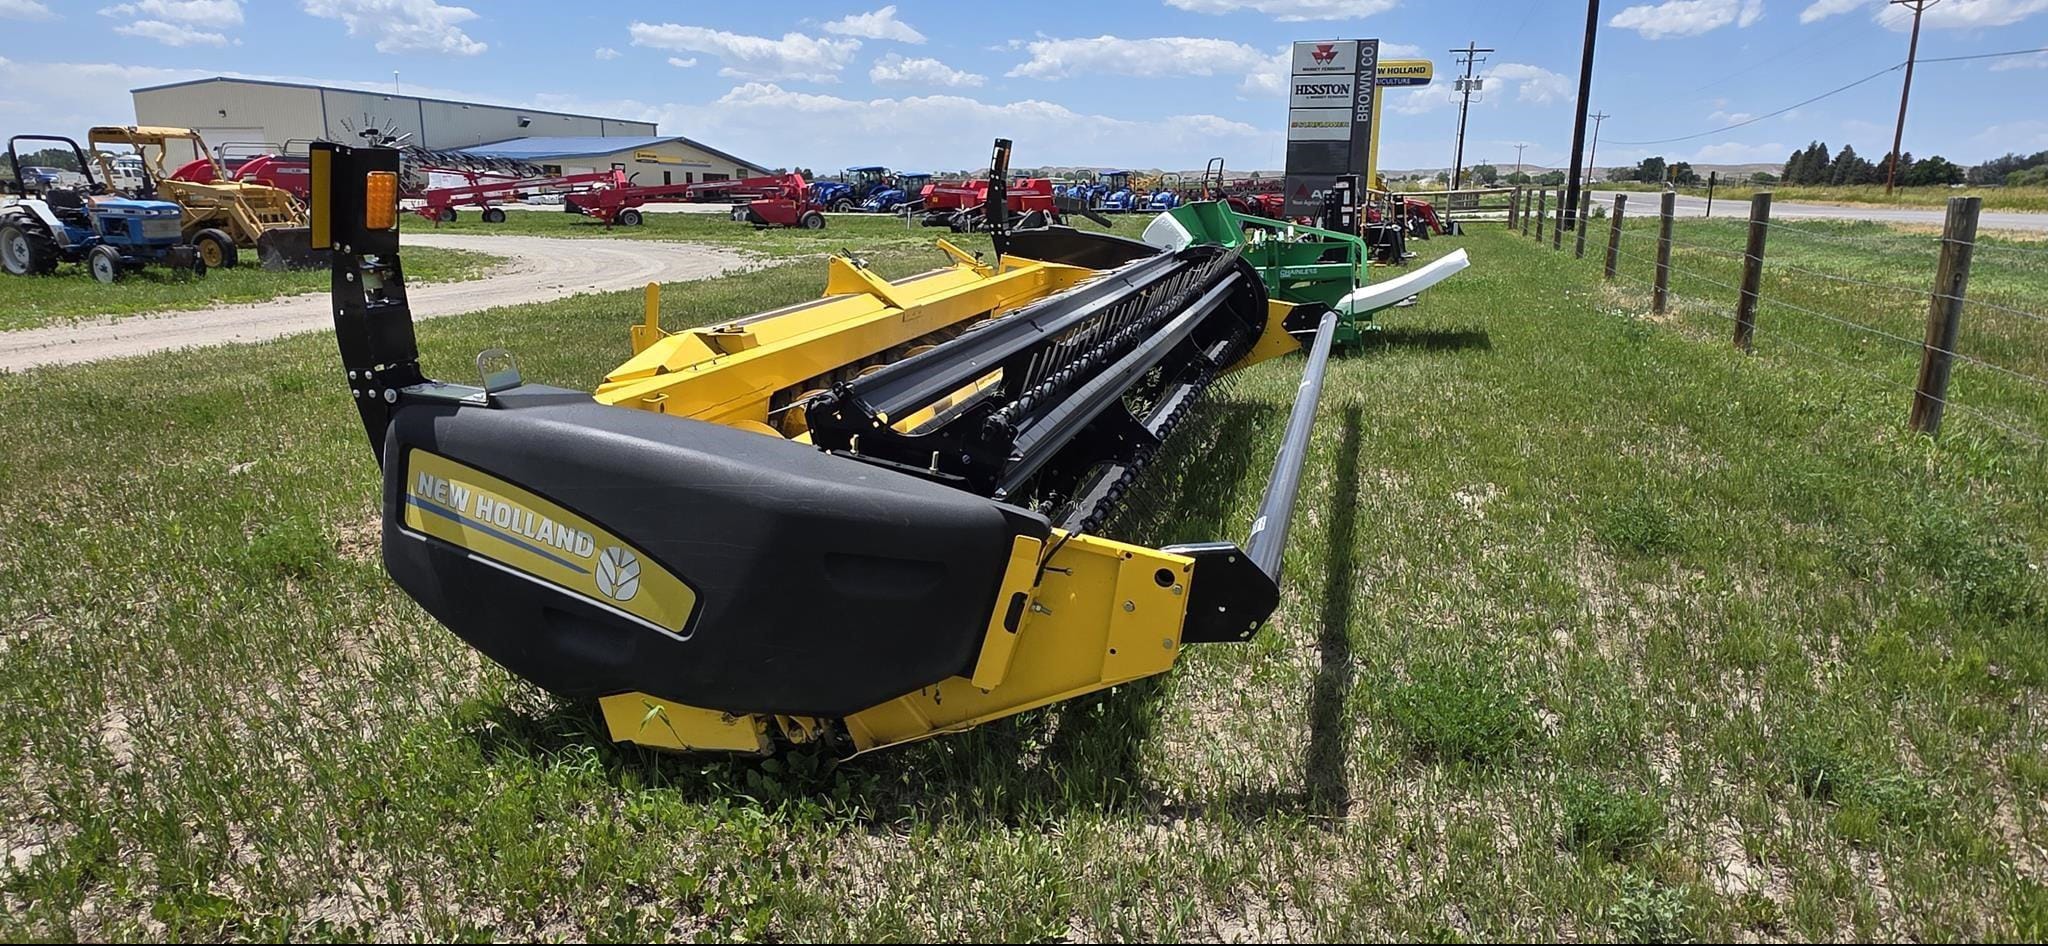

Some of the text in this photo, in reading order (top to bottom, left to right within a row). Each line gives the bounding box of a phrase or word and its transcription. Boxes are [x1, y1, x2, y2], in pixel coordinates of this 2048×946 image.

[1387, 66, 1426, 74] HOLLAND
[1295, 83, 1351, 95] HESSTON
[1357, 71, 1372, 121] BROWN
[417, 471, 595, 558] NEW HOLLAND
